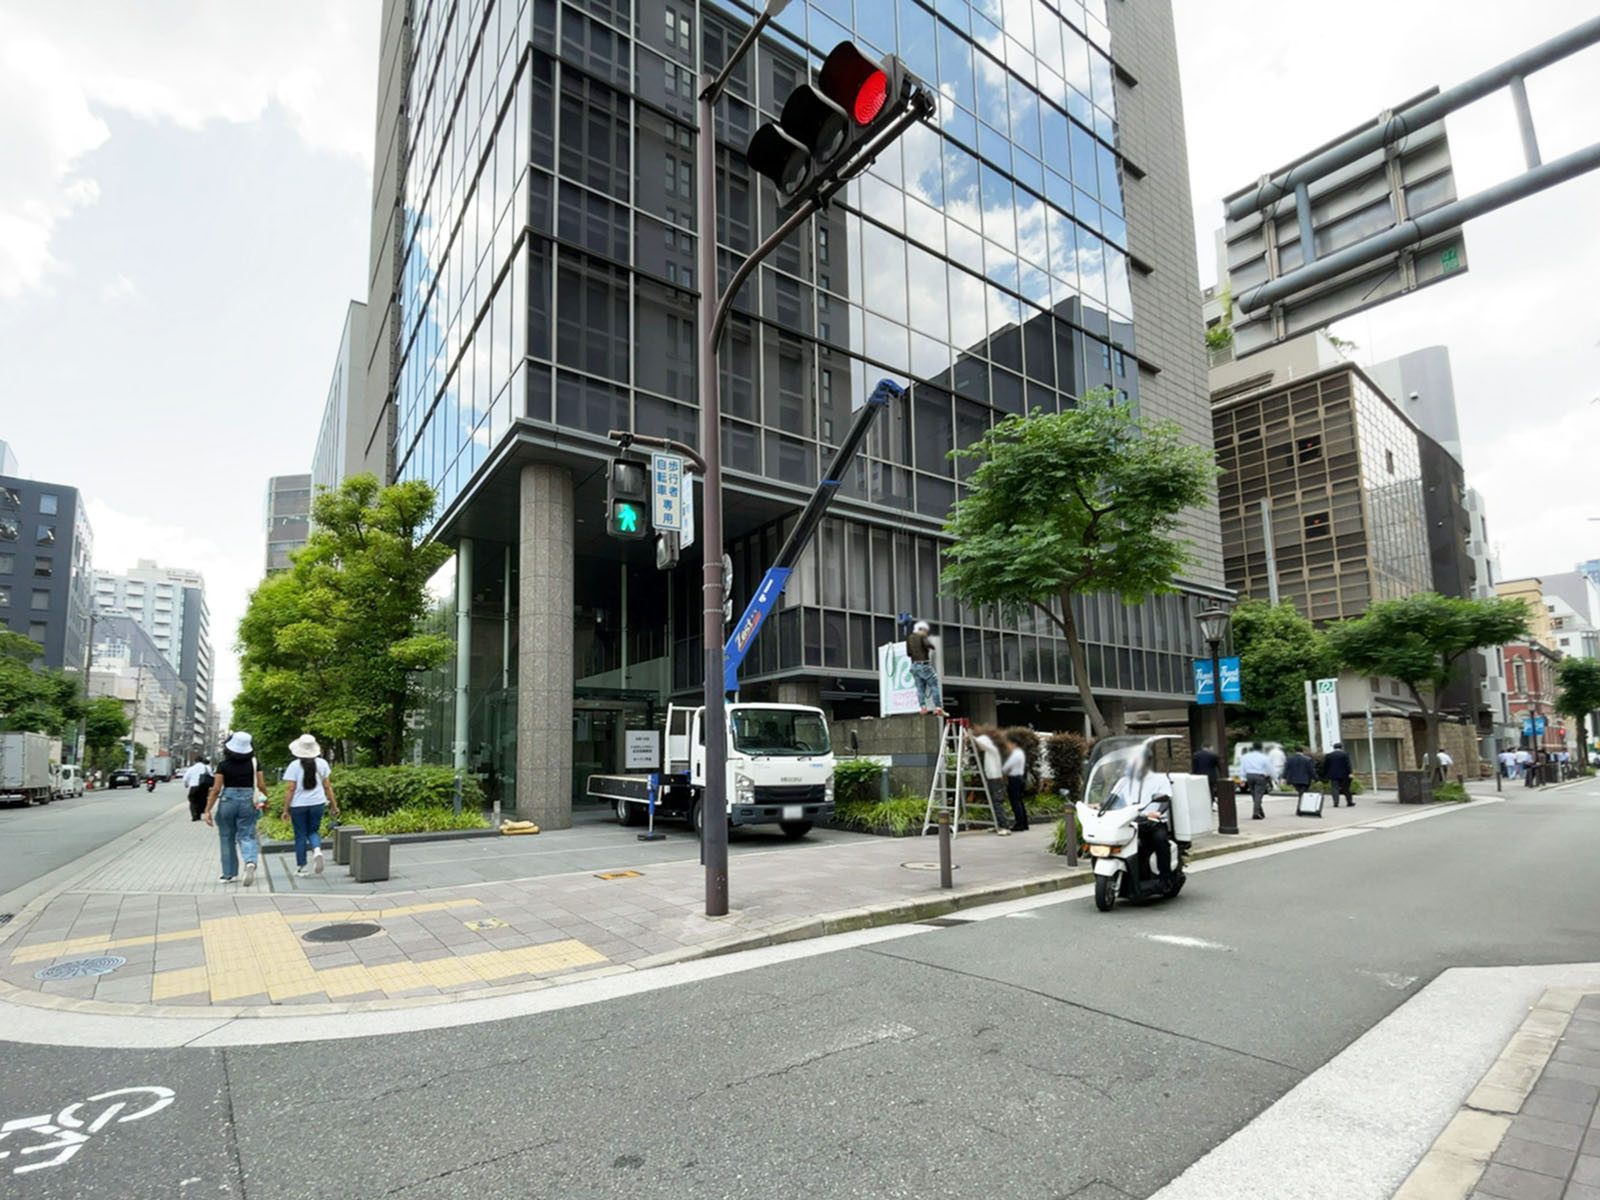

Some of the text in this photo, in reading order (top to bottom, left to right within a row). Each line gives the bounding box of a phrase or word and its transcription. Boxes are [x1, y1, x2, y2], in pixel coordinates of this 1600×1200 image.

[656, 458, 667, 496] 自転車
[668, 460, 679, 498] 歩行者
[663, 499, 673, 525] 専用
